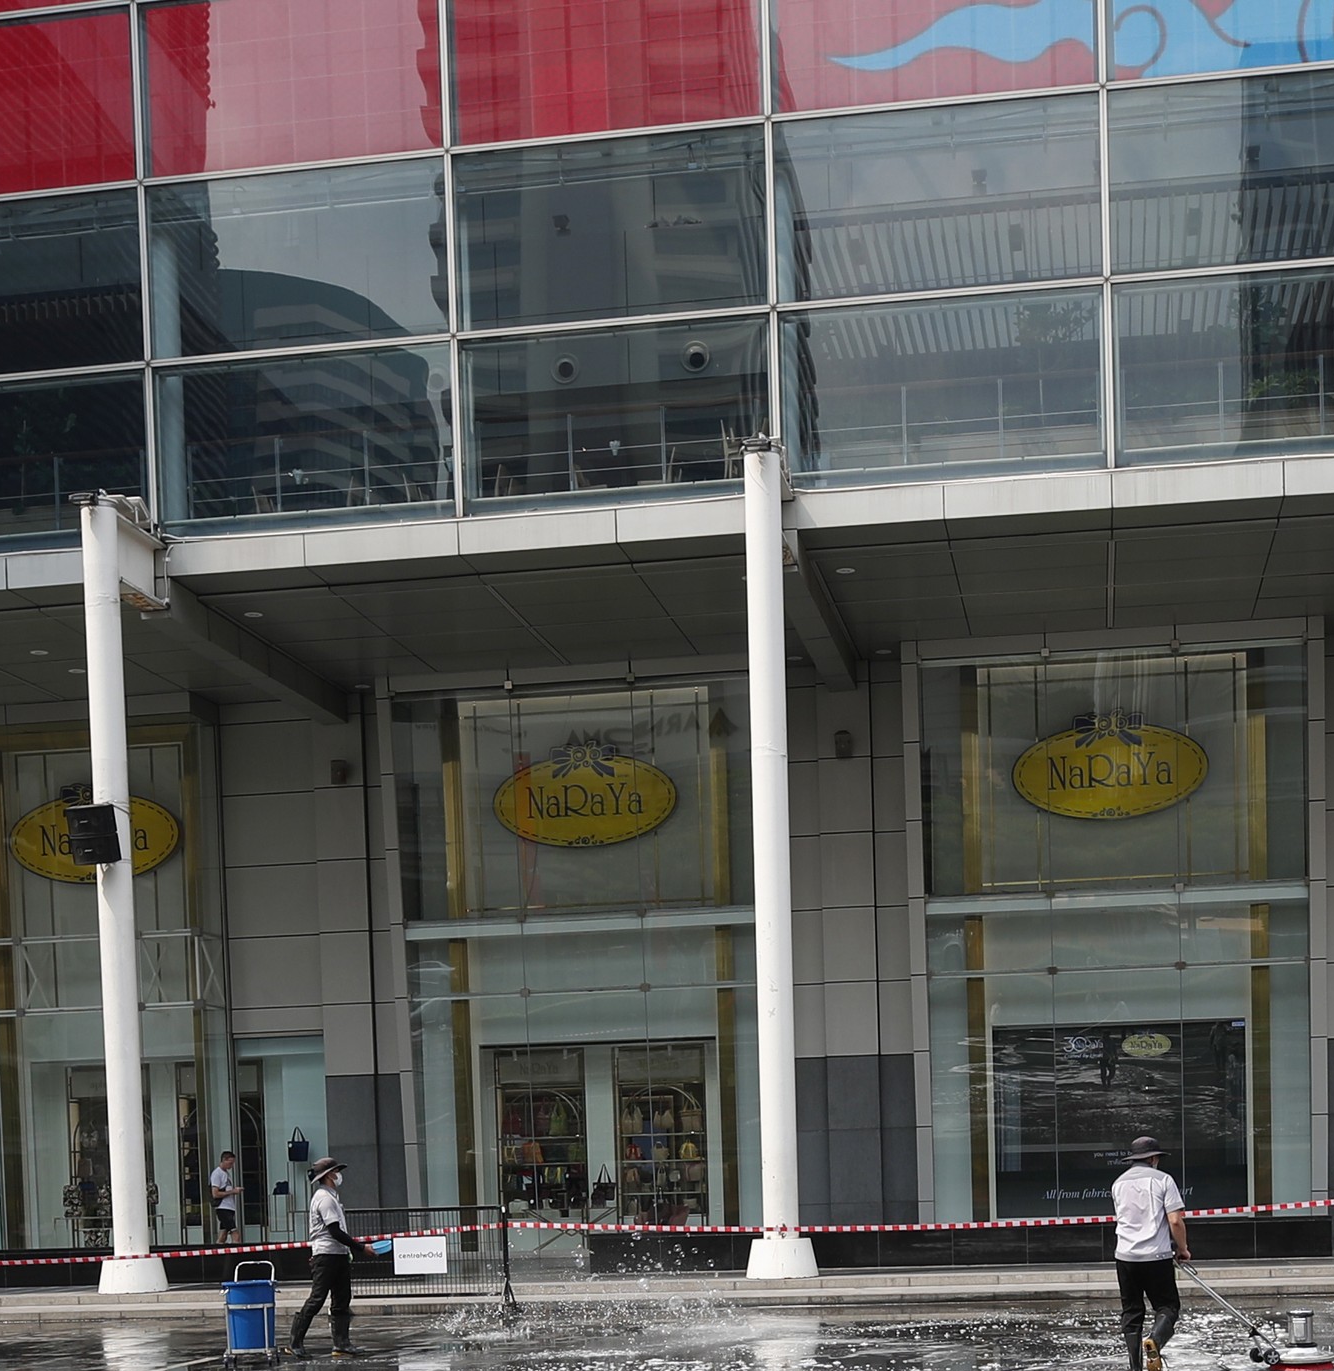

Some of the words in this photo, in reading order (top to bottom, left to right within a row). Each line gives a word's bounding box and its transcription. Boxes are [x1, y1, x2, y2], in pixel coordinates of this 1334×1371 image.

[1048, 751, 1173, 791] NaRaYa
[526, 783, 644, 819] NaRaYa
[398, 1251, 443, 1259] centralwOrld
